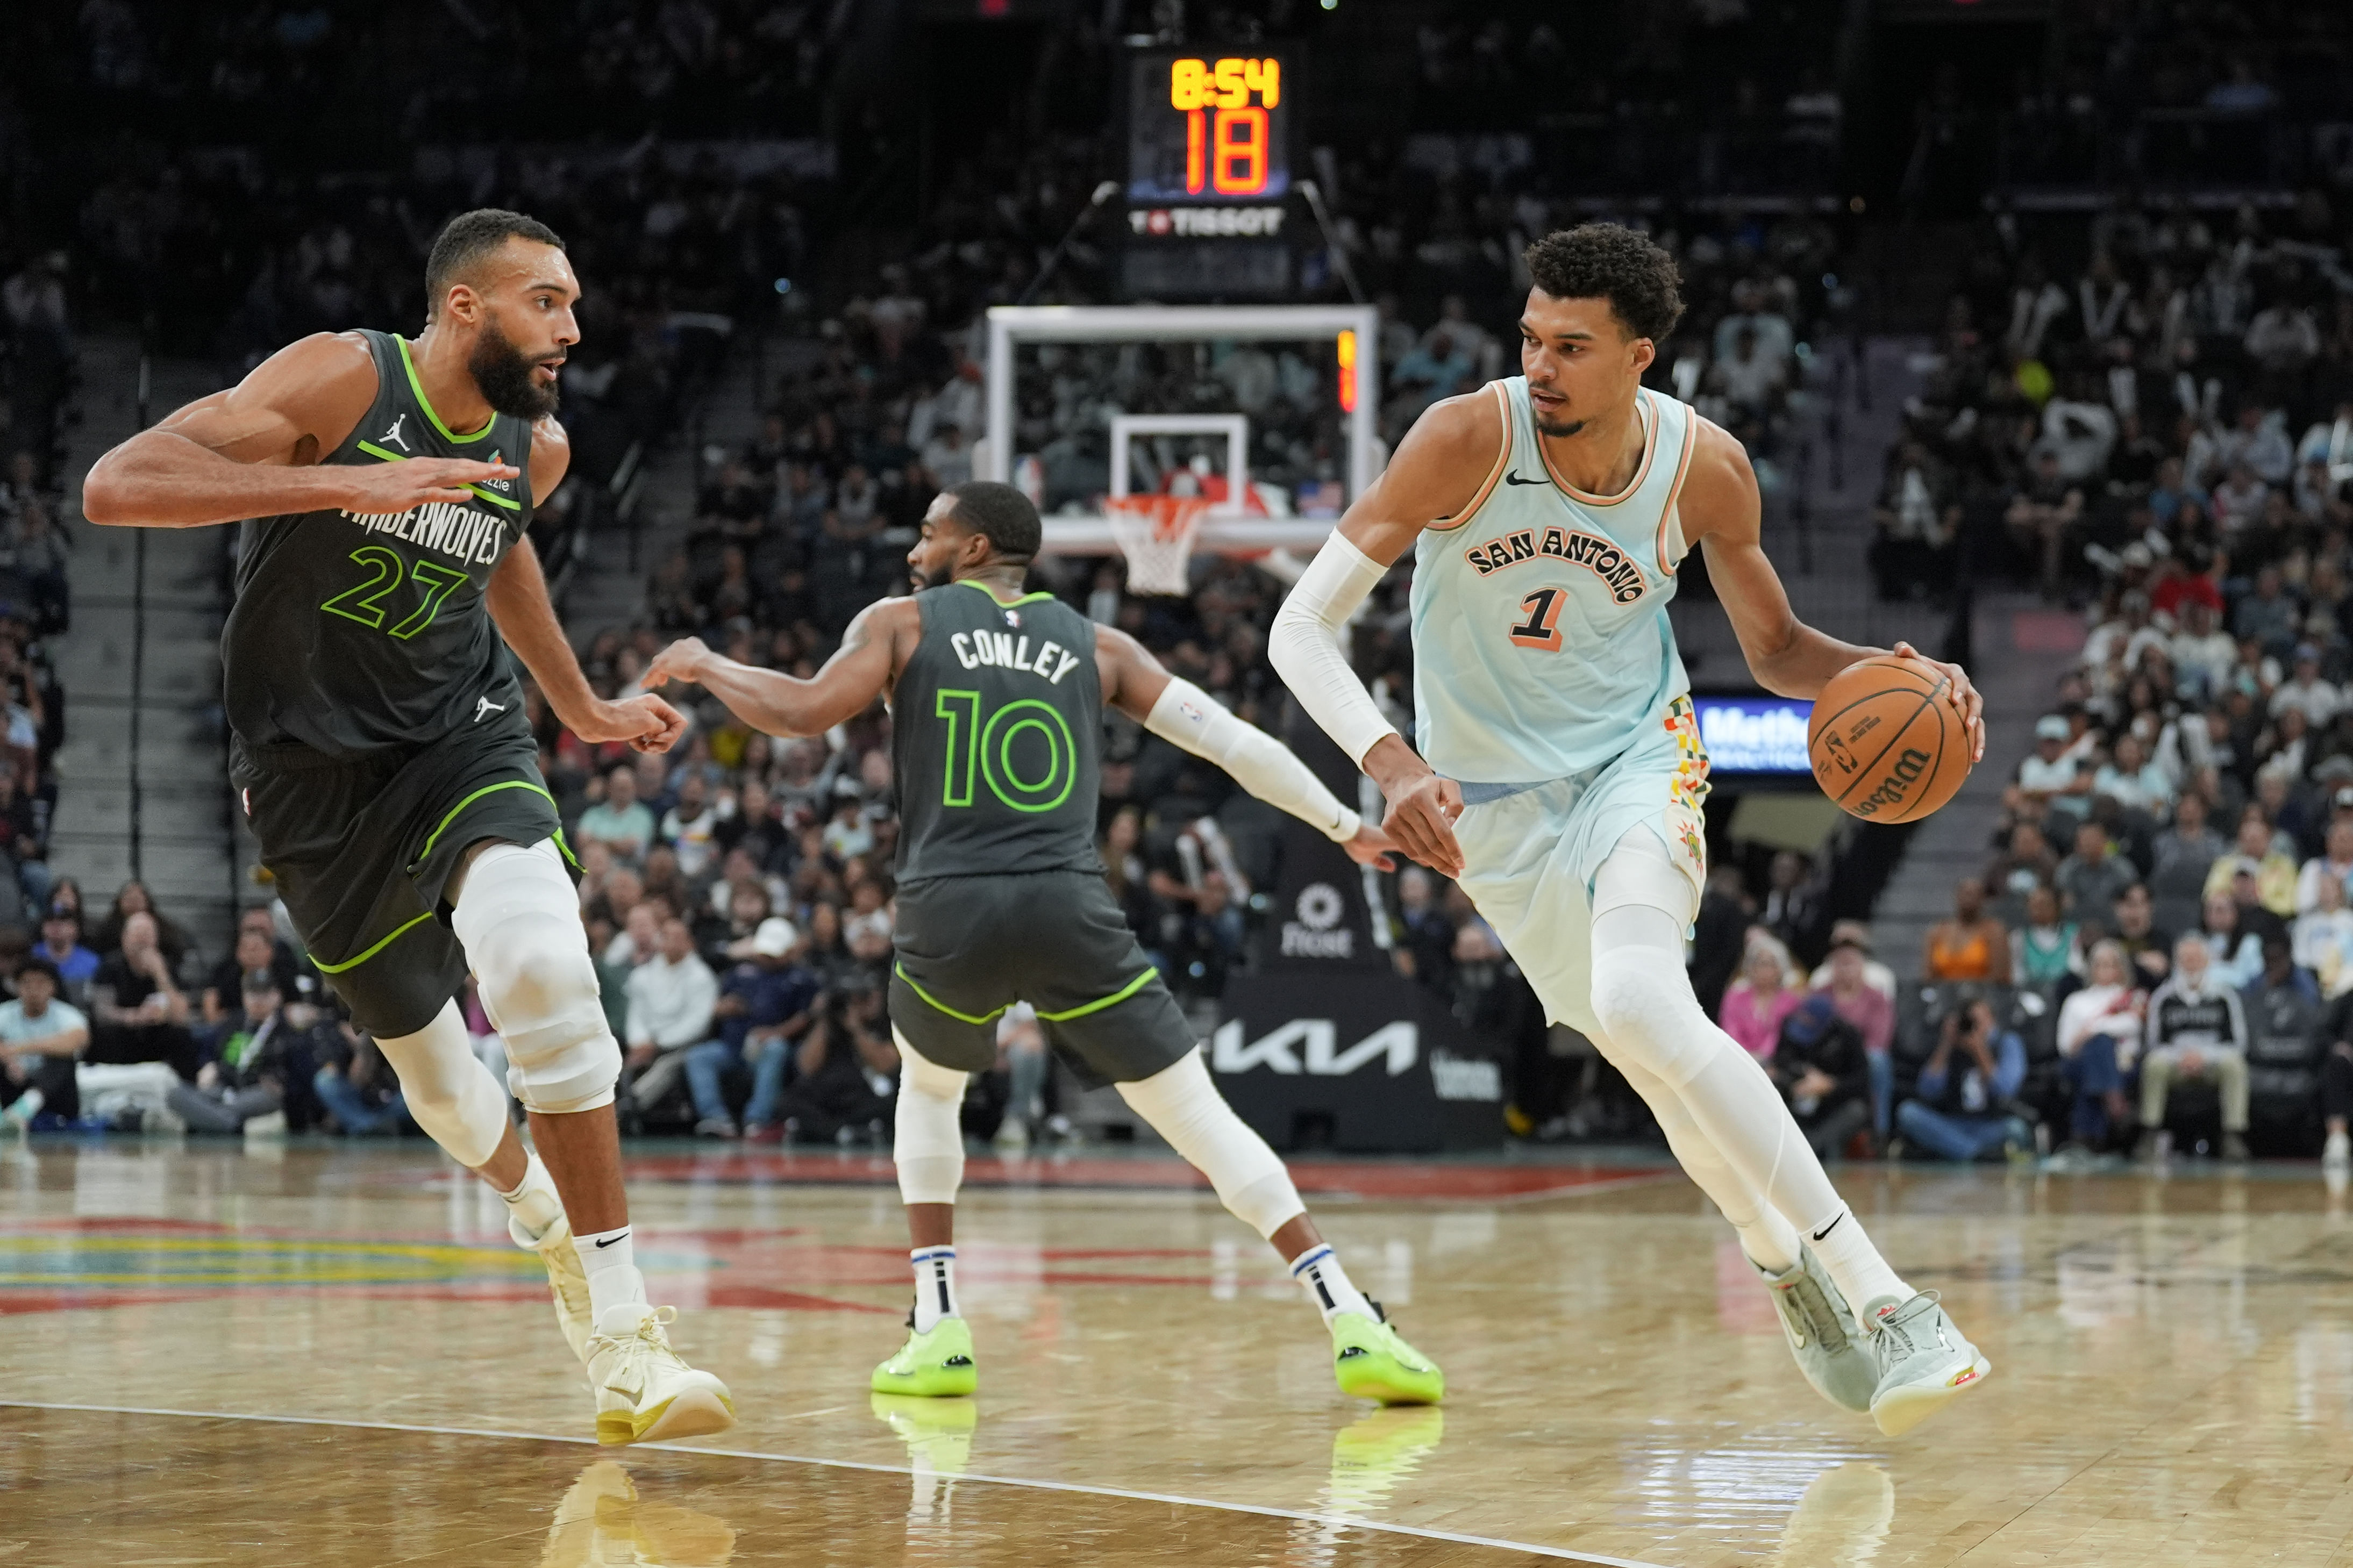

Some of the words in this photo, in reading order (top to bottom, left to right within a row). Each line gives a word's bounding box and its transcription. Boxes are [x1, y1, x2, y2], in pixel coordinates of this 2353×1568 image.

[1172, 58, 1280, 110] 8:54
[1186, 106, 1269, 195] 18
[320, 546, 468, 640] 27
[1465, 529, 1537, 577] SAN
[1539, 526, 1646, 605] ANTONIO
[1509, 586, 1568, 653] 1
[951, 629, 1079, 685] CONLEY
[936, 688, 1076, 813] 10
[1848, 748, 1931, 817] Wilson
[1212, 1019, 1420, 1075] KIA
